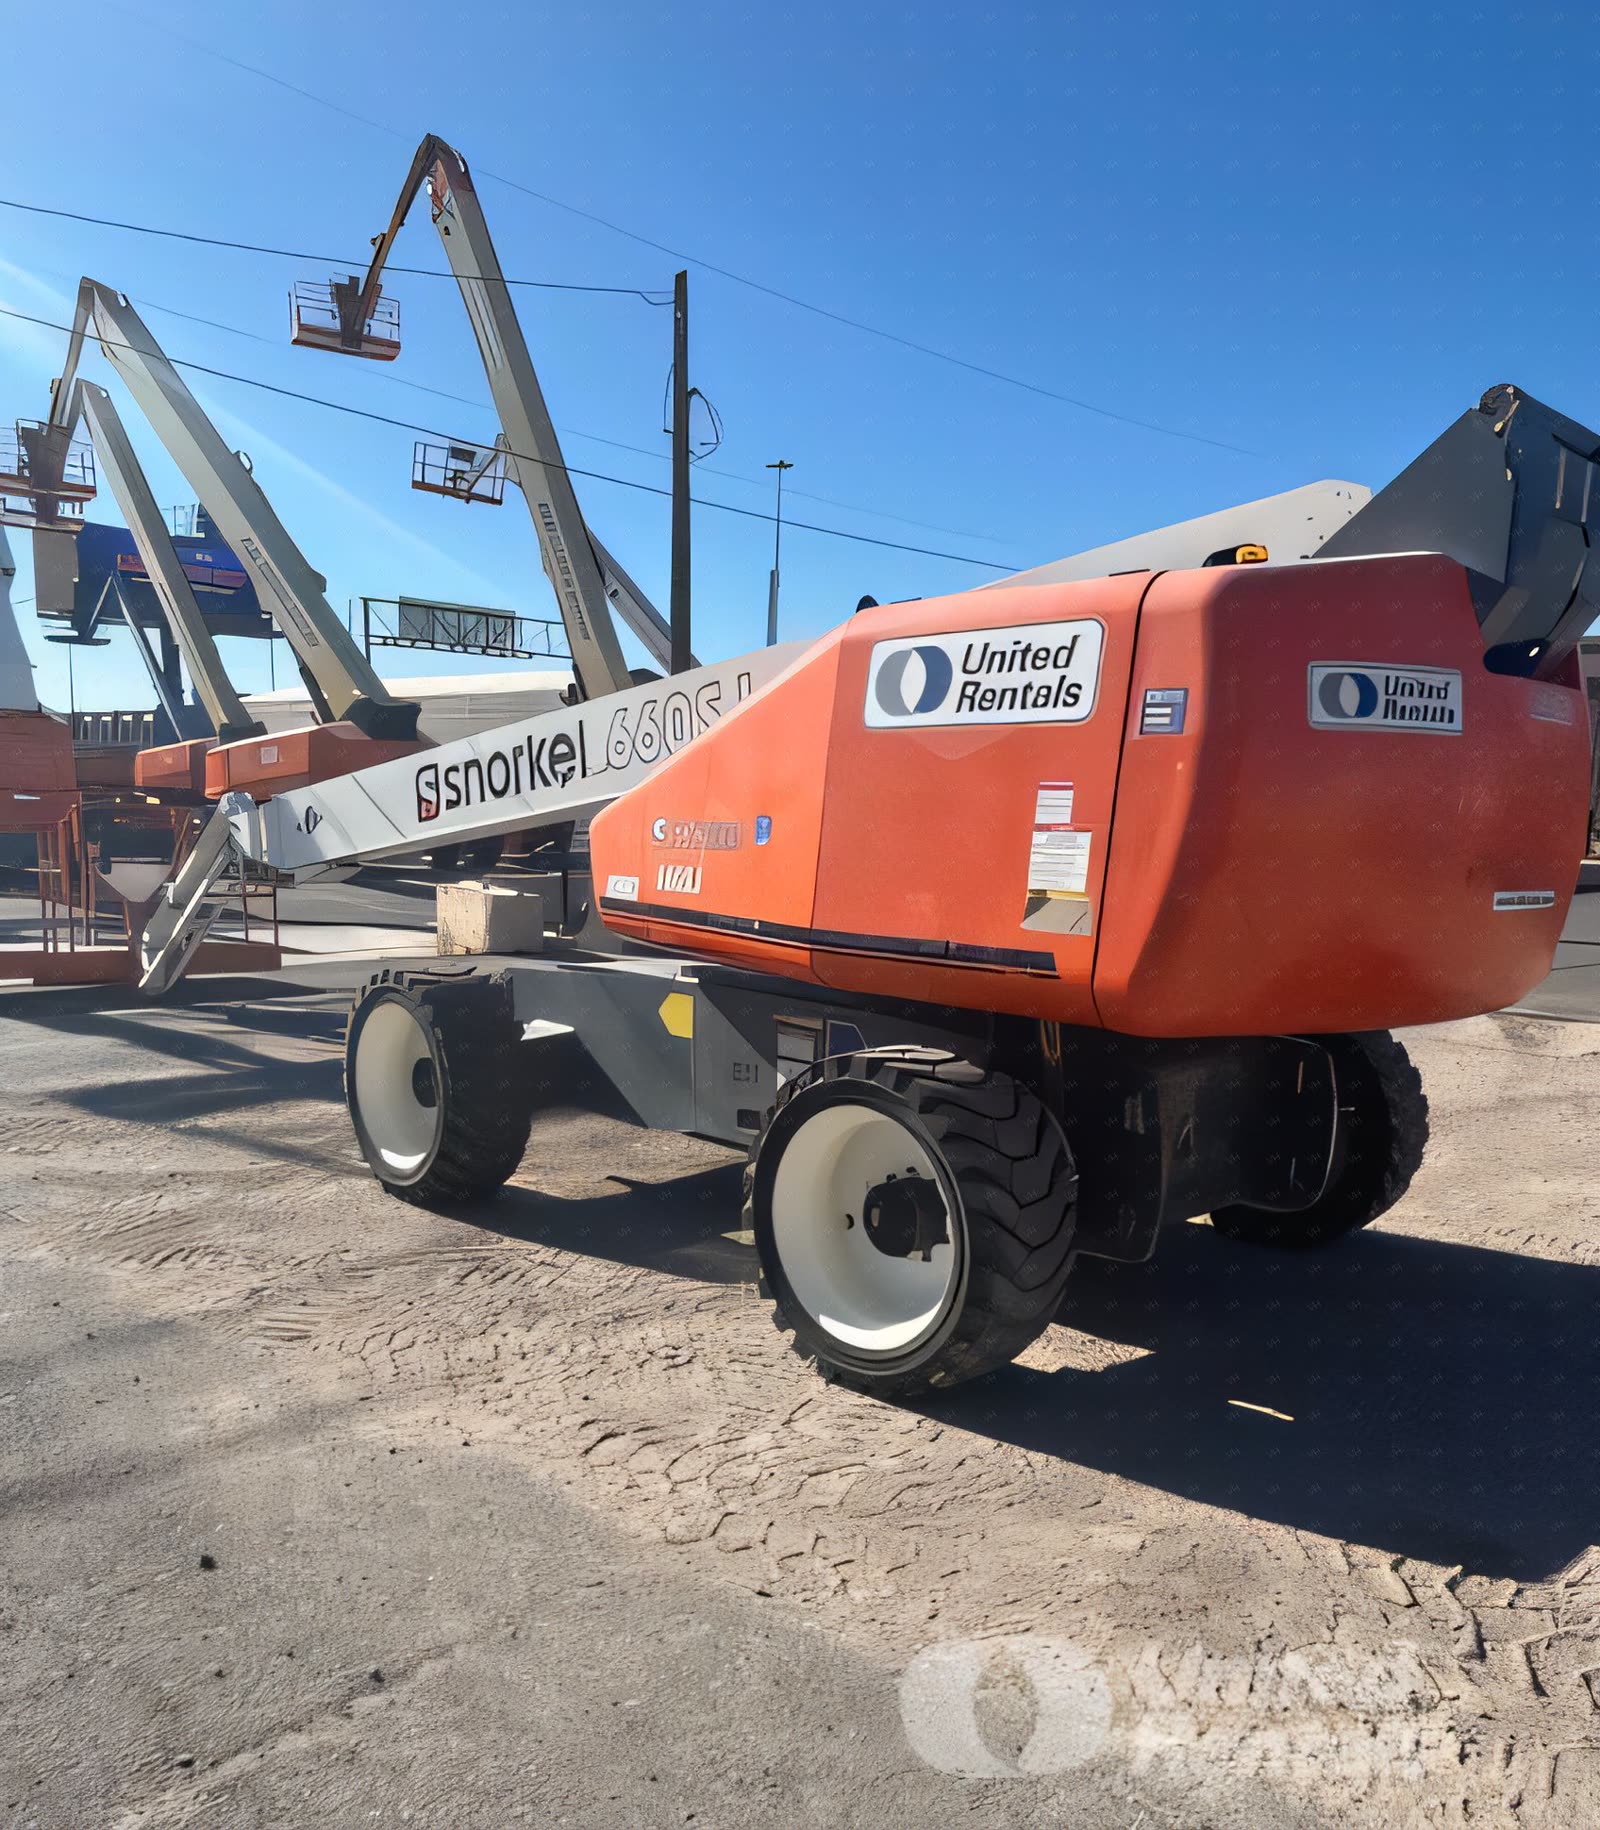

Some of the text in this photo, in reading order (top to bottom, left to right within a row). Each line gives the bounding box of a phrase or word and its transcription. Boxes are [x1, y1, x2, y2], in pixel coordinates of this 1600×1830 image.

[961, 634, 1080, 675] United
[956, 675, 1083, 713] Rentals
[444, 719, 590, 811] snorkel
